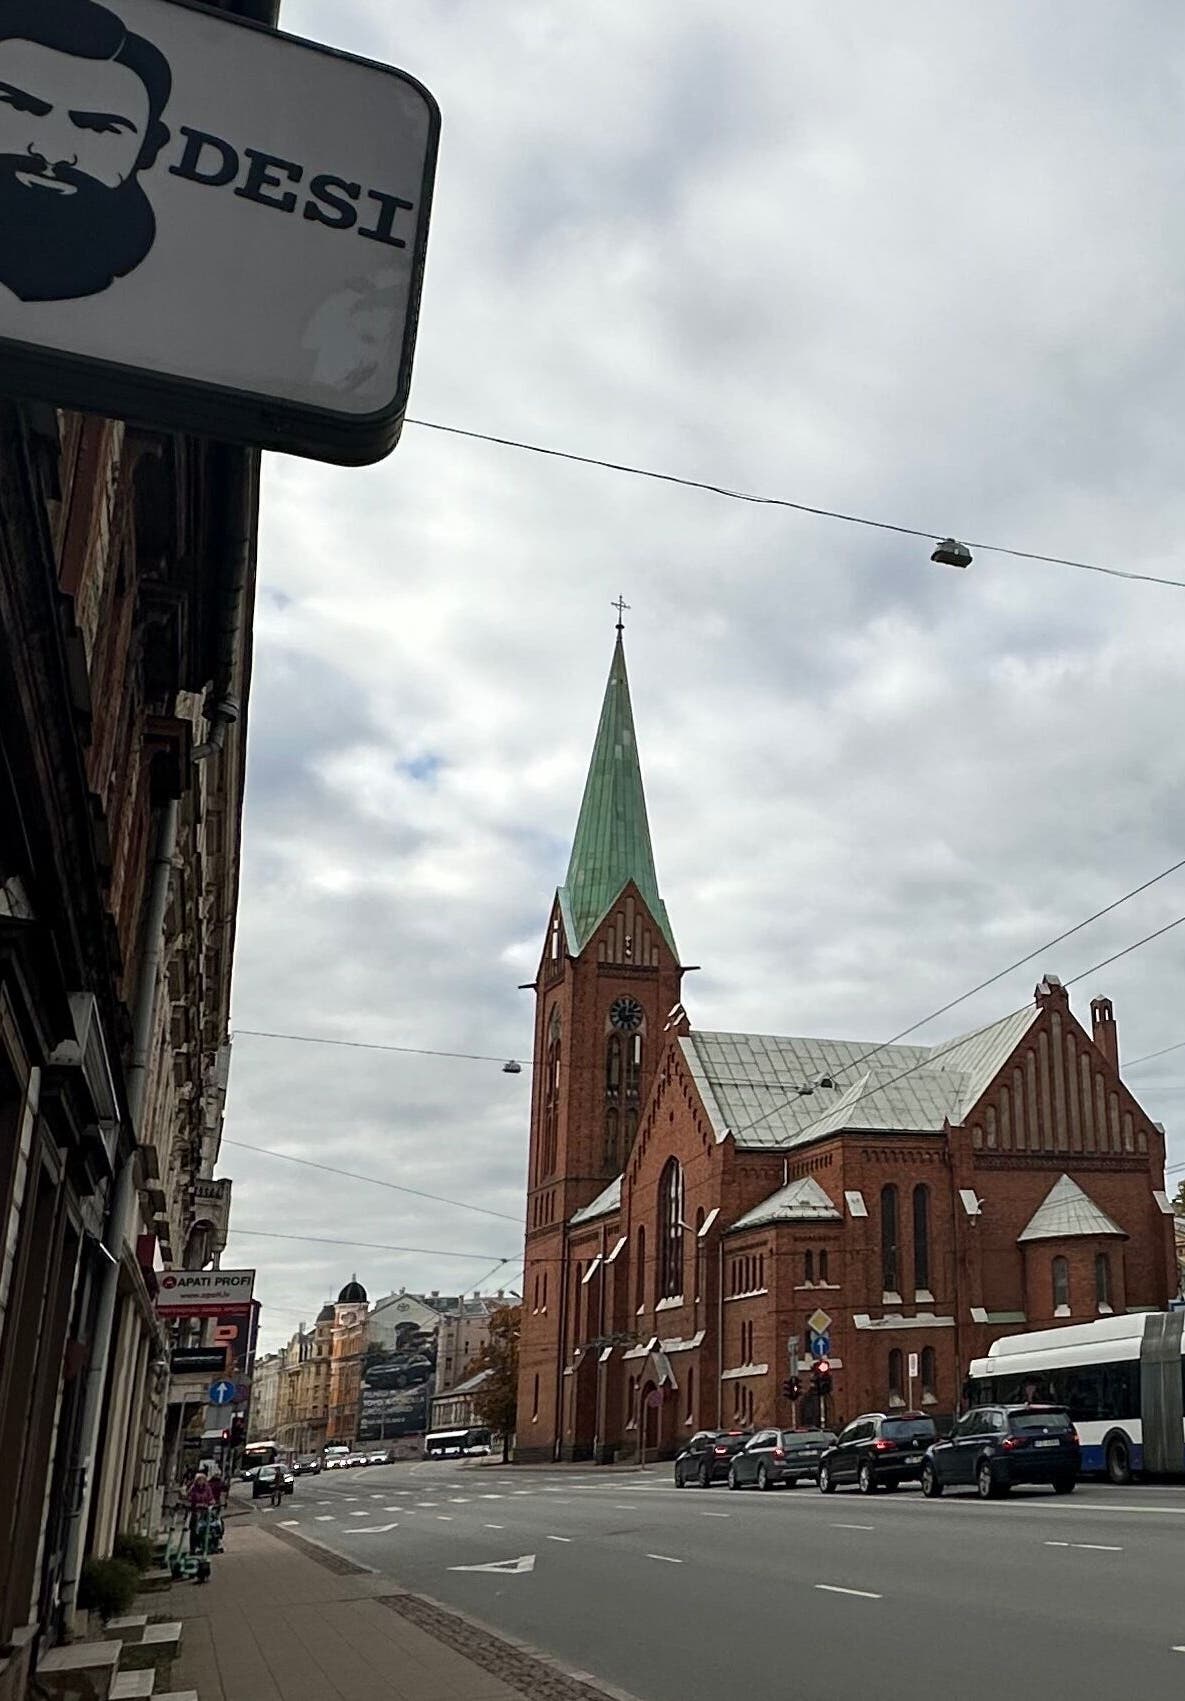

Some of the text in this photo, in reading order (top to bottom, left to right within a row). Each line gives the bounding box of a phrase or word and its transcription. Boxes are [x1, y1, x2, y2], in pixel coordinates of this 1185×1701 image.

[169, 126, 413, 248] DESI
[178, 1276, 251, 1287] APATI PROFI
